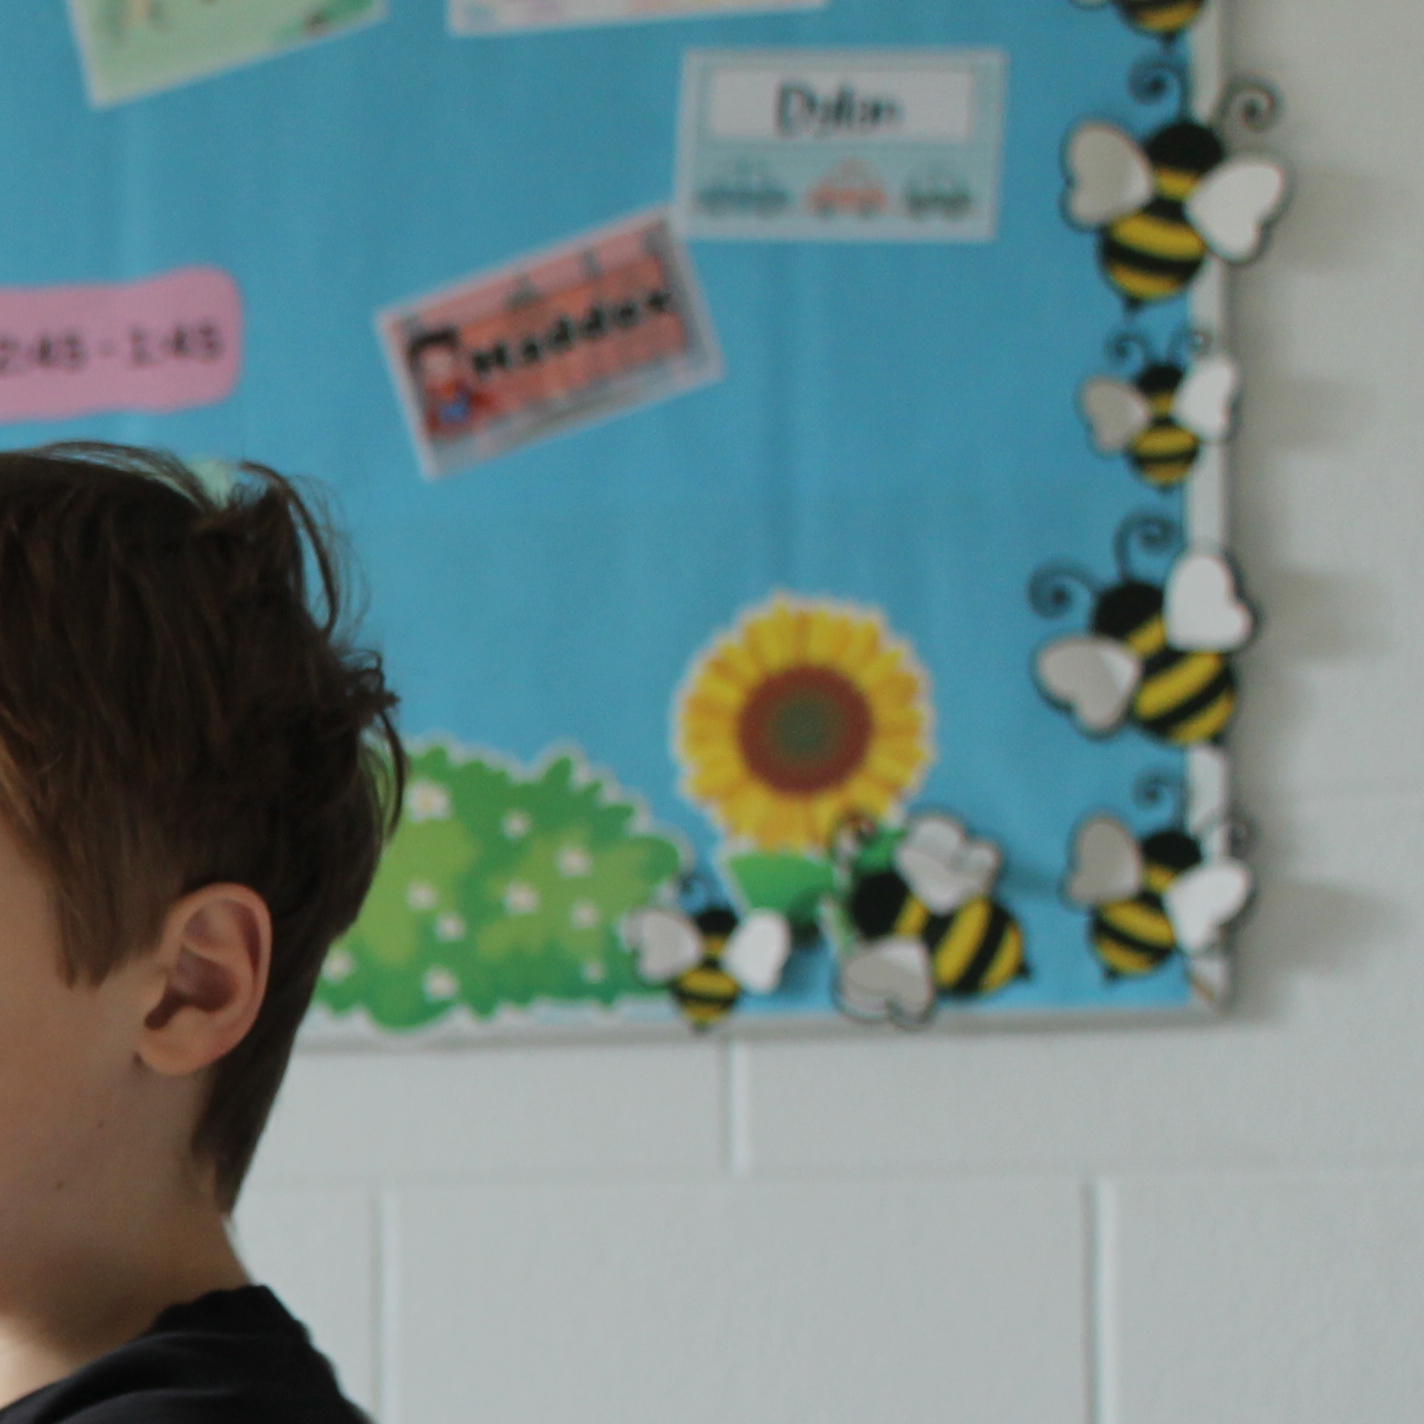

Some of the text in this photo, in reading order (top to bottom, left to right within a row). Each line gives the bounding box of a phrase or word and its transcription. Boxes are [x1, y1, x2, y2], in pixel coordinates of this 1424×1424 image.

[776, 80, 903, 140] Dylan
[126, 317, 224, 370] 1:45
[471, 288, 673, 376] Maddox
